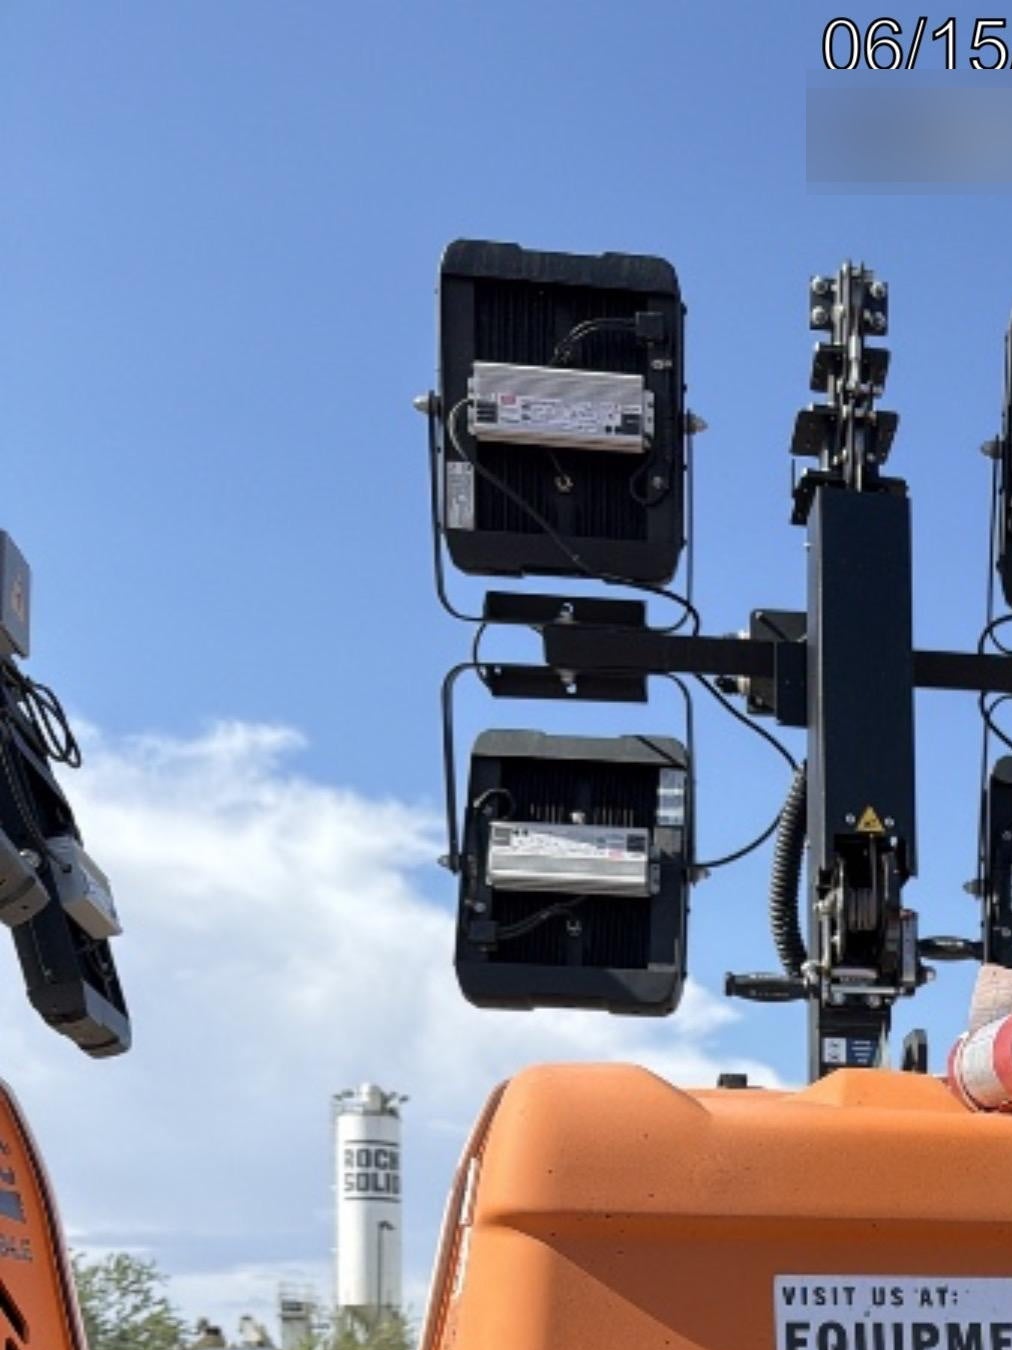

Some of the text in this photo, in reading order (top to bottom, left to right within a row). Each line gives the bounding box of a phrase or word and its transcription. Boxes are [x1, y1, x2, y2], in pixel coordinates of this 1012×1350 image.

[781, 1285, 959, 1308] VISIT US AT:
